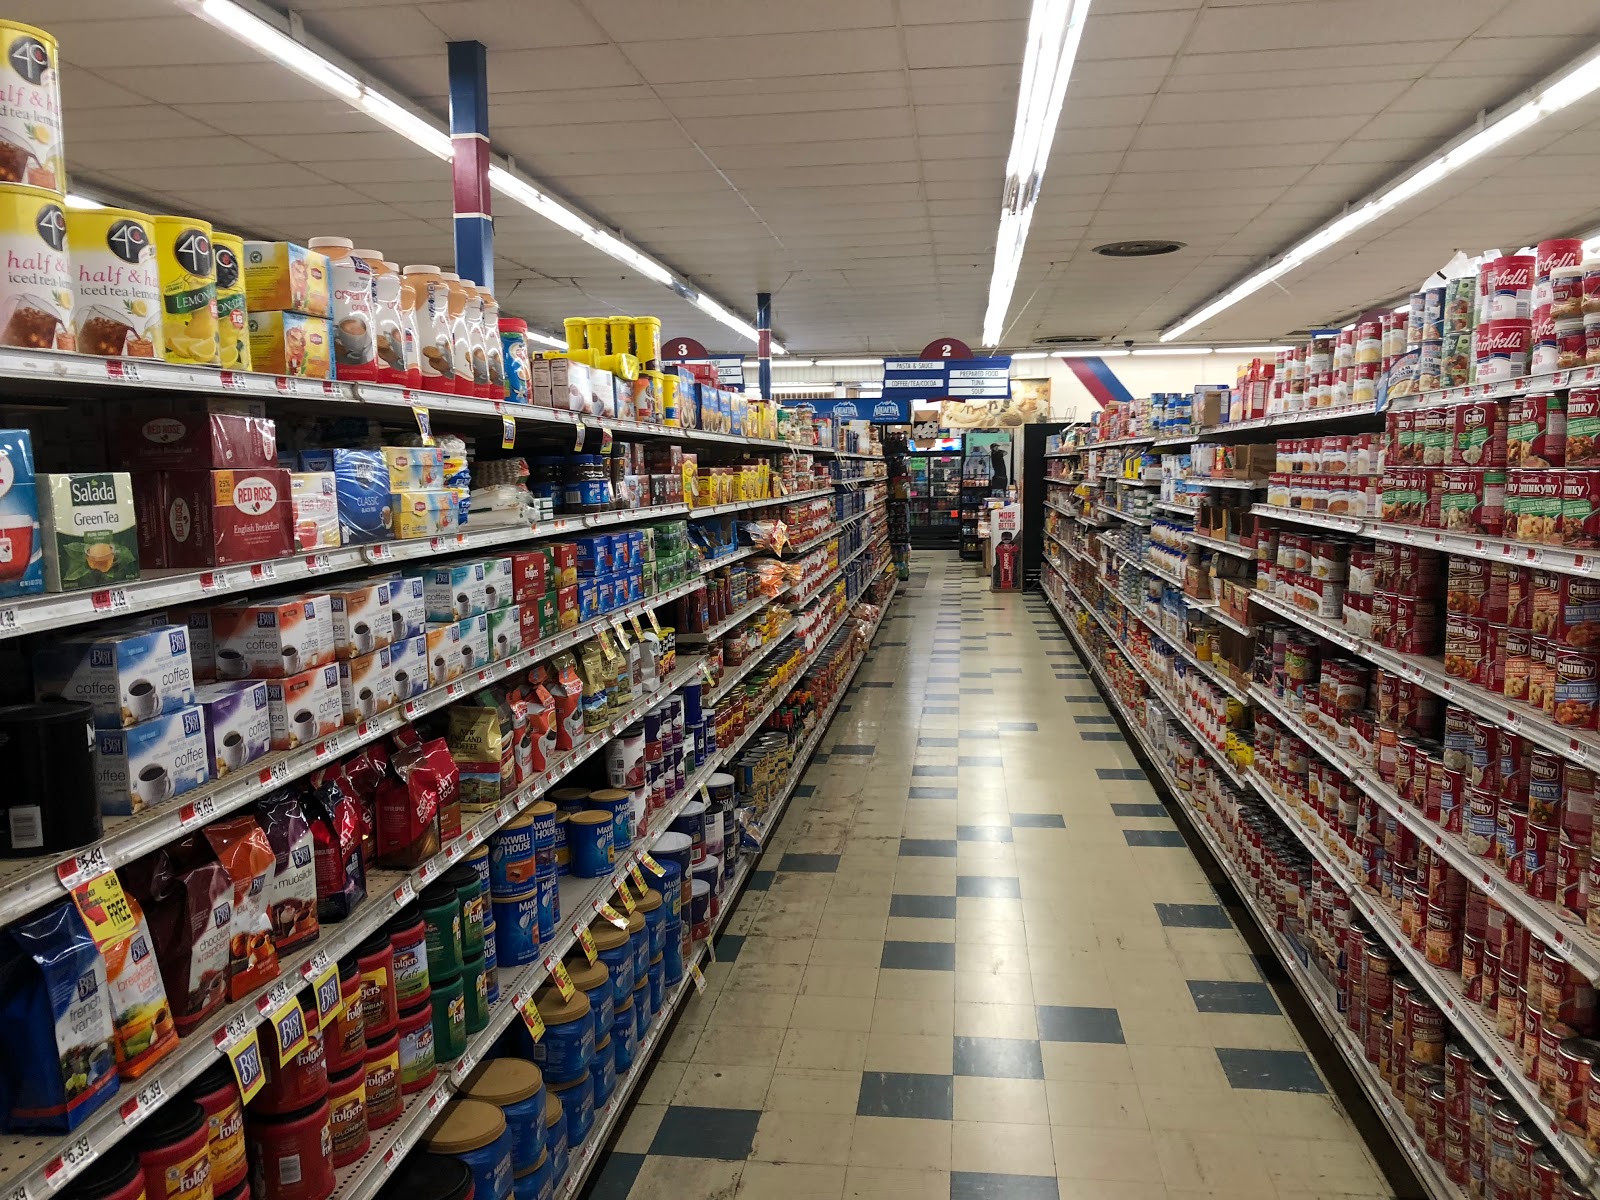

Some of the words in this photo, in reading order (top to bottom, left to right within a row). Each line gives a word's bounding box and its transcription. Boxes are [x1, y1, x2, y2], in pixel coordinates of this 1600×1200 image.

[7, 251, 50, 273] half
[8, 272, 37, 284] iced
[79, 265, 124, 285] half
[128, 270, 141, 283] &
[143, 271, 159, 288] ha
[80, 286, 107, 297] iced
[678, 343, 688, 356] 3
[941, 344, 951, 357] 2
[72, 481, 115, 502] Salada
[237, 486, 252, 504] RED
[253, 486, 273, 502] ROSE
[357, 496, 380, 506] CLASSIC
[74, 512, 103, 526] Green
[103, 510, 119, 523] Tea
[233, 524, 255, 535] English
[254, 521, 280, 532] Breakfast
[425, 594, 450, 603] coffee
[373, 615, 391, 628] coffee
[407, 608, 425, 619] coffee
[246, 639, 278, 650] coffee
[301, 637, 319, 651] coffee
[162, 667, 190, 686] coffee
[1557, 661, 1595, 677] CHUNKY
[76, 682, 116, 694] coffee
[319, 696, 340, 714] coffee
[248, 721, 269, 737] coffee
[458, 728, 476, 736] NEW
[174, 747, 204, 768] coffee
[270, 761, 287, 780] $6.69
[194, 796, 214, 817] $6.69
[491, 832, 531, 845] MAXWELL
[504, 842, 531, 855] HOUSE
[278, 868, 313, 889] mudslide
[107, 898, 132, 926] FREE
[311, 950, 328, 968] $6.39
[267, 981, 286, 1001] $6.39
[70, 995, 101, 1021] french
[227, 1015, 246, 1035] $6.39
[298, 1047, 324, 1066] Folgers
[365, 1070, 395, 1087] Folgers
[138, 1080, 161, 1105] $6.39
[331, 1103, 363, 1124] Folgers
[63, 1136, 90, 1164] $6.39
